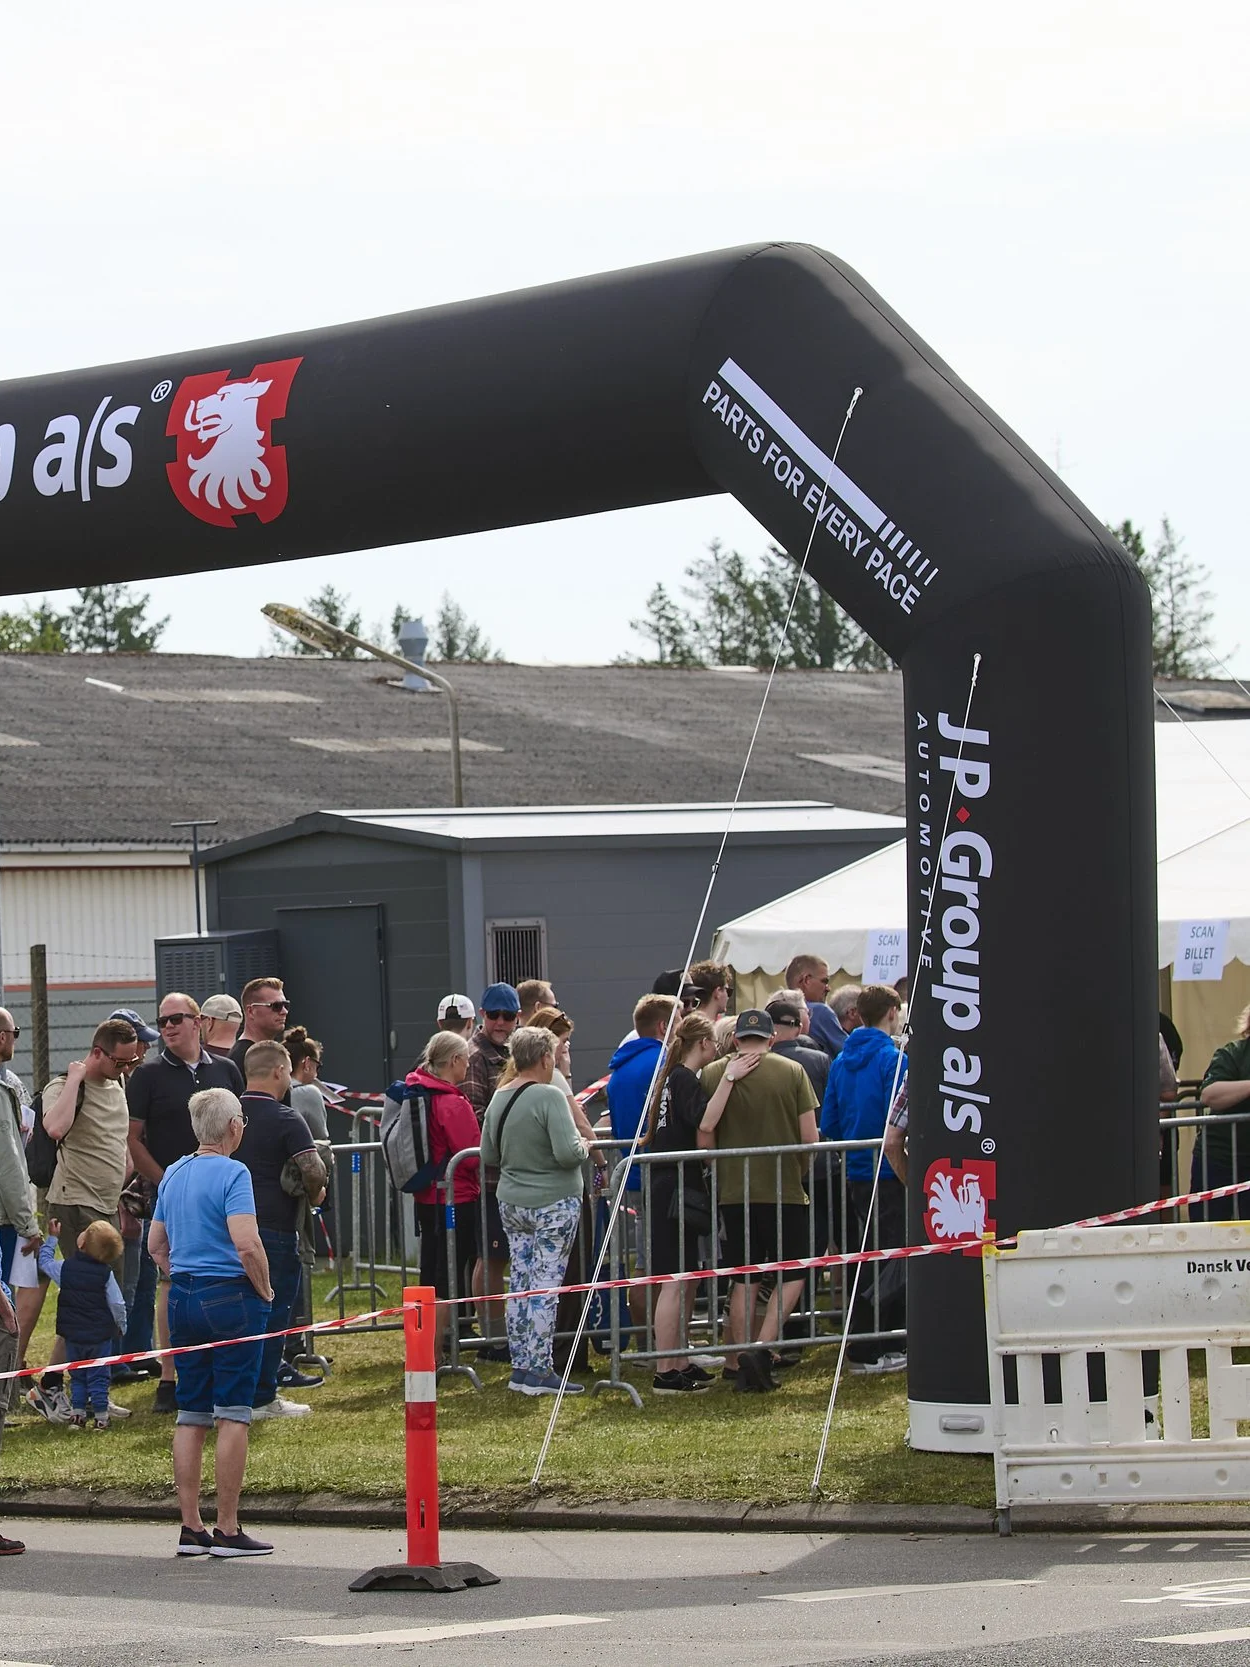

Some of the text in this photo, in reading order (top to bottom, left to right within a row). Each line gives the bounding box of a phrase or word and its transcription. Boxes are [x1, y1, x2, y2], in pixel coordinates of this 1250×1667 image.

[702, 380, 921, 615] PARTS FOR EVERY PACE
[916, 711, 933, 969] AUTOMOTIVE
[931, 830, 993, 1032] Group
[1190, 926, 1215, 938] SCAN
[877, 934, 901, 946] SCAN
[872, 954, 900, 966] BILLET
[1184, 947, 1215, 960] BILLET
[1187, 1259, 1233, 1274] Dansk
